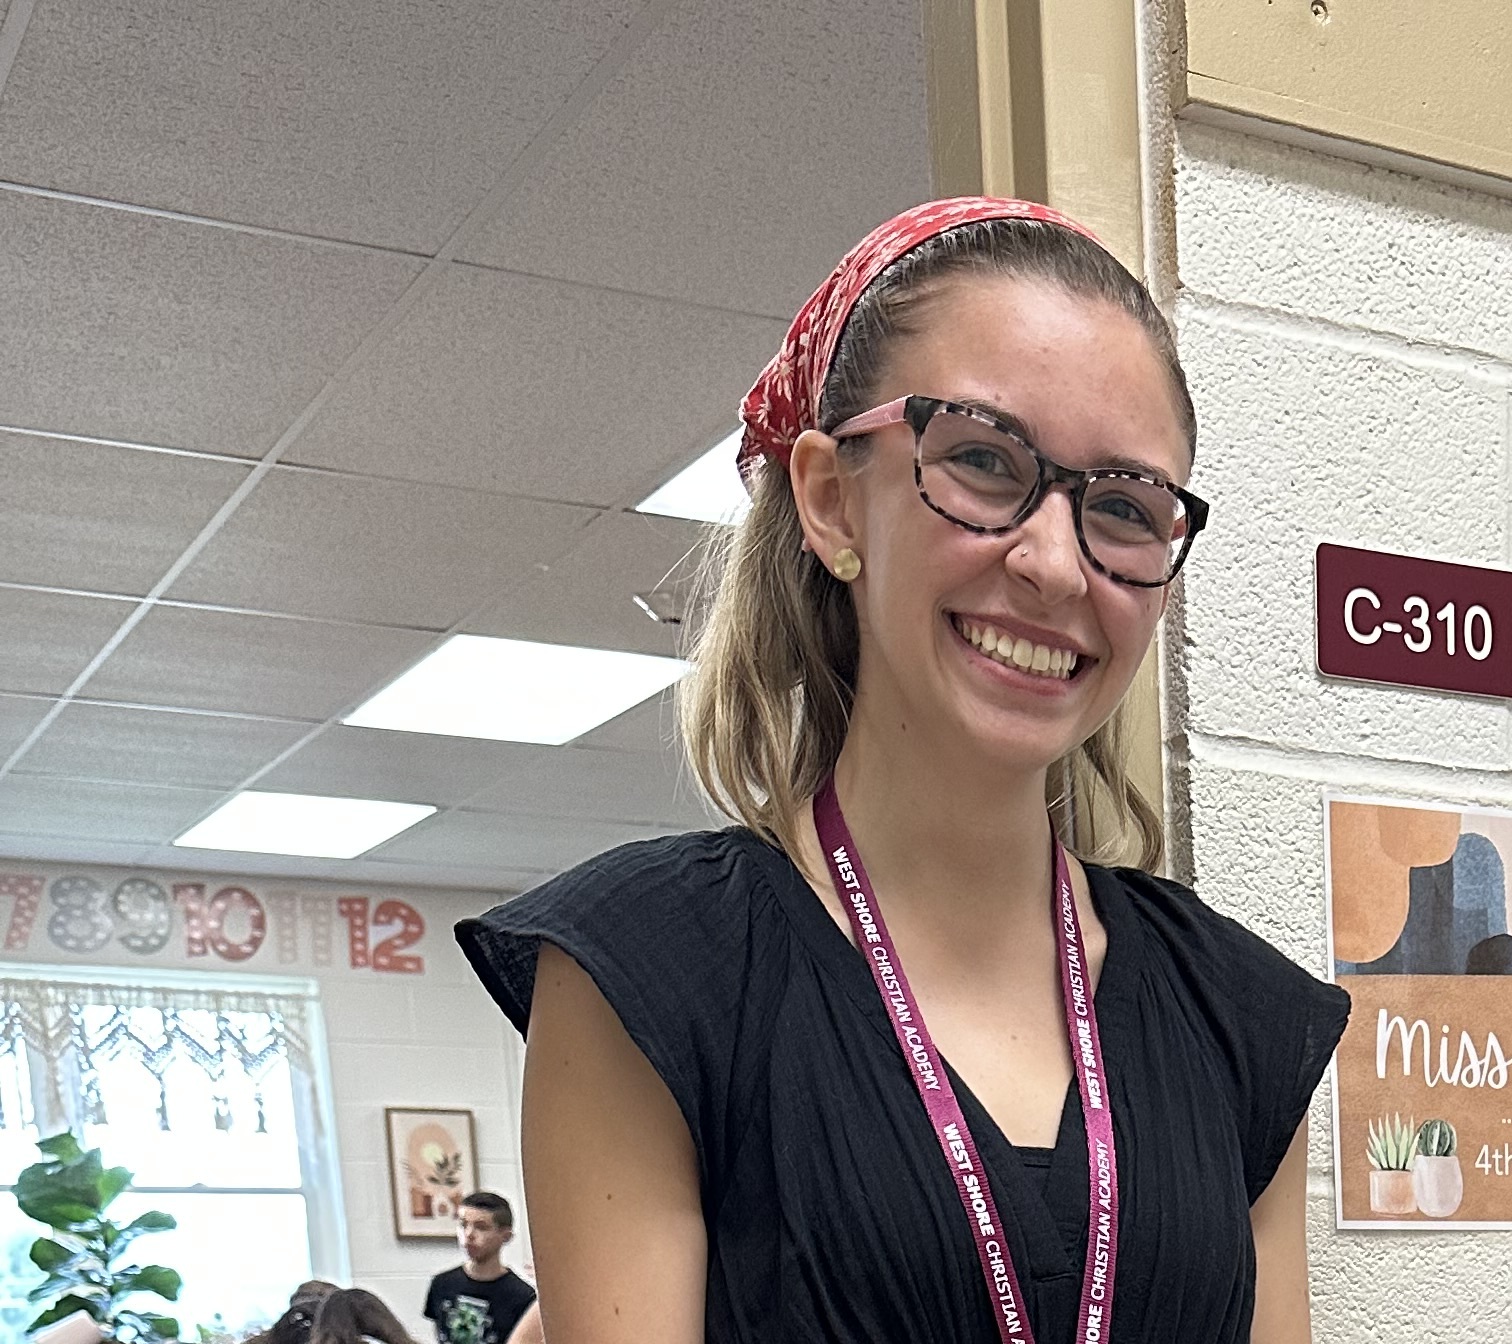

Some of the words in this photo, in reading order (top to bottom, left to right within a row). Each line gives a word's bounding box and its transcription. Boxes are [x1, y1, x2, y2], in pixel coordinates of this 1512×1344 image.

[1344, 588, 1494, 661] C-310
[0, 873, 45, 951] 7
[48, 875, 113, 954] 8
[113, 877, 171, 955] 9
[172, 883, 267, 963] 10
[337, 896, 426, 974] 12
[1061, 879, 1078, 944] ACADEMY
[832, 845, 860, 890] WEST
[850, 892, 882, 944] SHORE
[872, 946, 912, 1023] CHRISTIAN
[902, 1024, 941, 1091] ACADEMY
[1067, 943, 1089, 1017] CHRISTIAN
[1076, 1018, 1097, 1069] SHORE
[1084, 1070, 1104, 1110] WEST
[1095, 1137, 1112, 1211] ACADEMY
[943, 1122, 974, 1172] WEST
[963, 1174, 995, 1237] SHORE
[985, 1239, 1023, 1334] CHRISTIAN
[1090, 1211, 1111, 1301] CHRISTIAN
